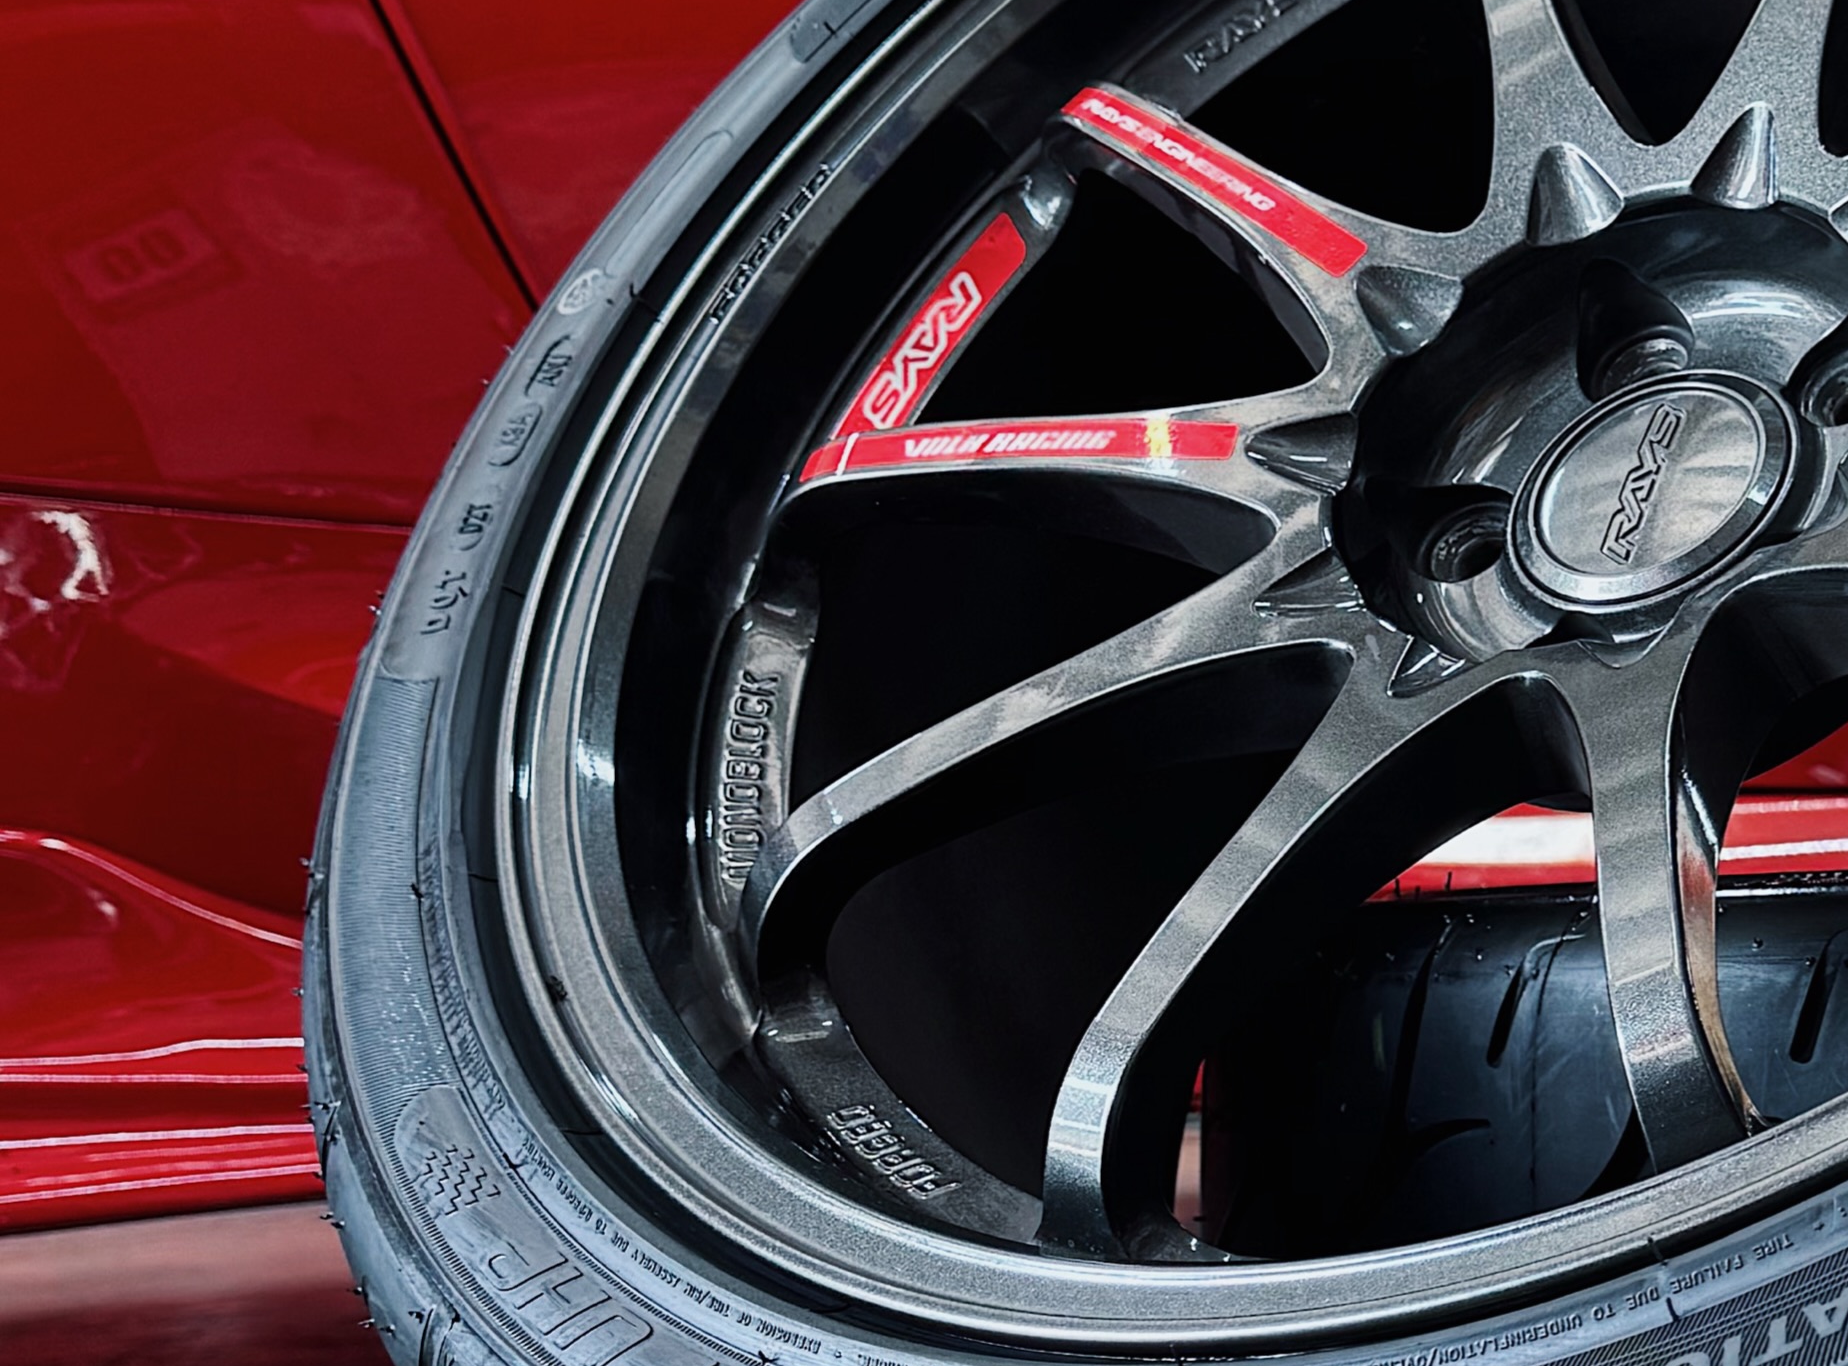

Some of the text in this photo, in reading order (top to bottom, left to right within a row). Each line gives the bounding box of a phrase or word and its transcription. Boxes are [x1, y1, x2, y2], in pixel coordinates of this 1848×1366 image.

[1081, 98, 1276, 213] RAYS ENGINEERING
[863, 272, 983, 429] RAYS
[904, 430, 1117, 458] VOLK RACING
[1601, 404, 1686, 565] RAYS
[723, 670, 779, 881] MONOBLOCK
[826, 1103, 962, 1201] FORGED
[1666, 1250, 1746, 1297] FAILURE
[1750, 1230, 1795, 1262] TIRE
[1589, 1301, 1616, 1324] TO
[1623, 1284, 1662, 1312] DUE
